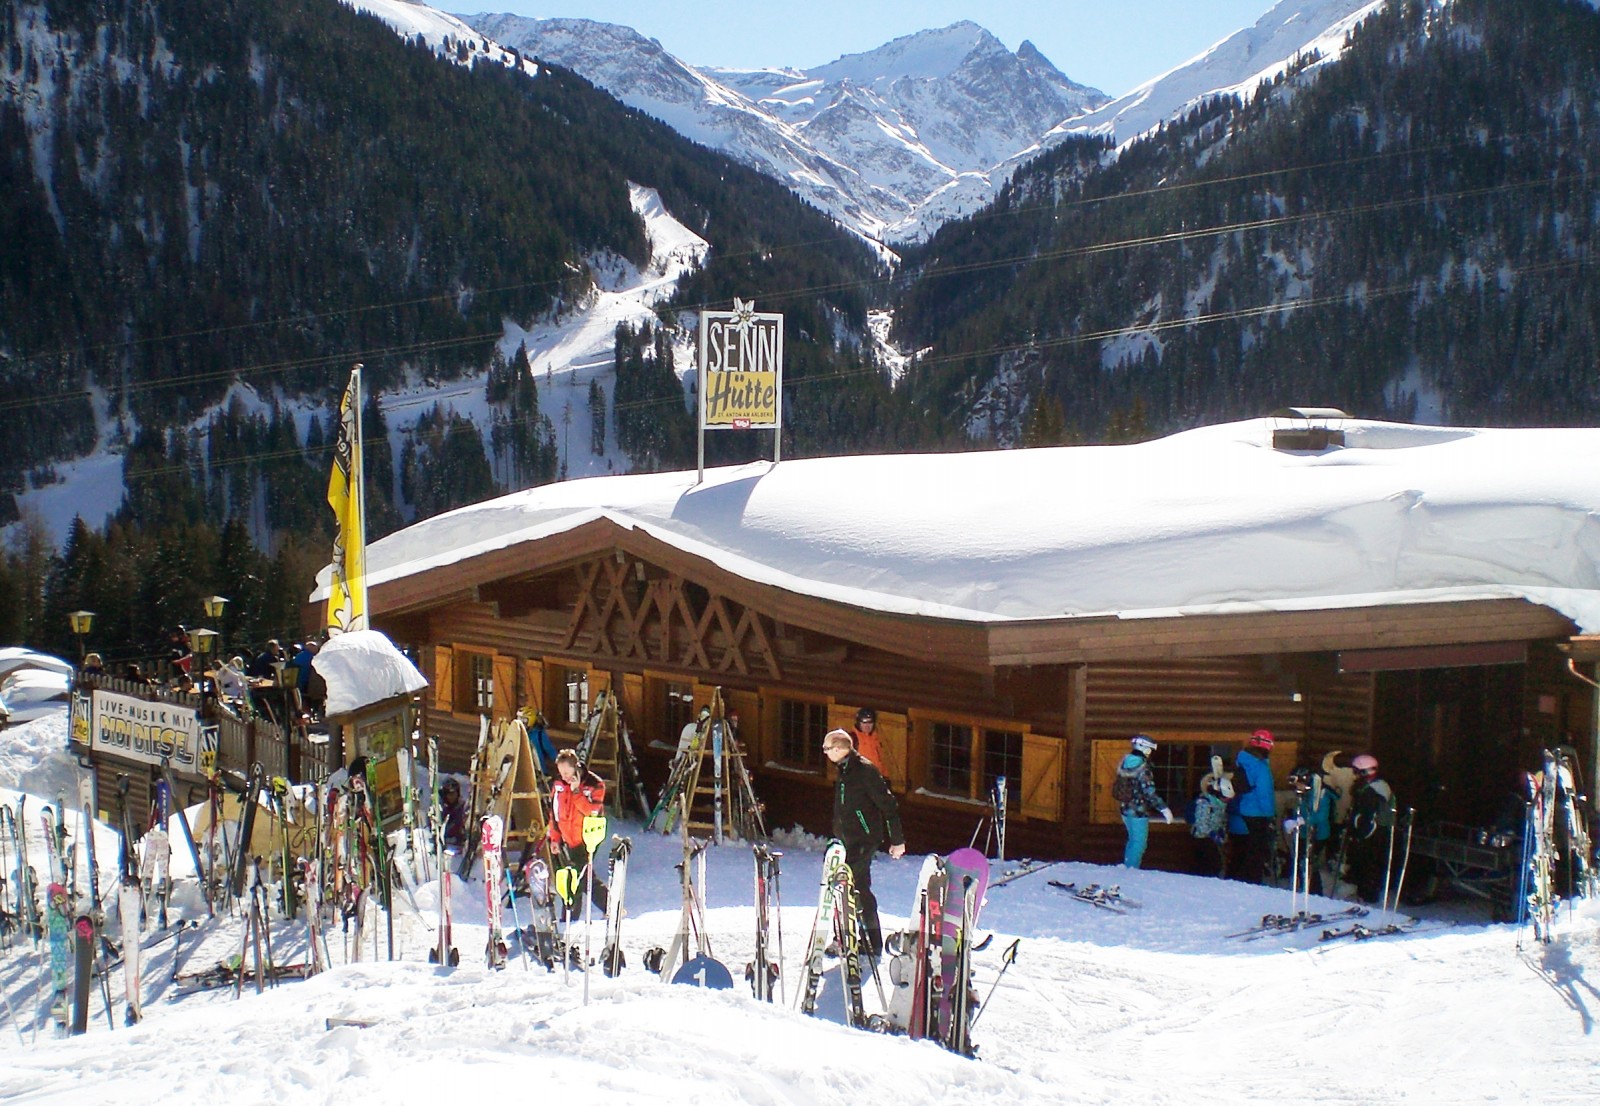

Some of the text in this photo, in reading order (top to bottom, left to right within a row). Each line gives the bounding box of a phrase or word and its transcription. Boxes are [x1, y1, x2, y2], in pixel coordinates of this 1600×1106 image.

[709, 321, 776, 373] SENN
[708, 371, 774, 418] Hütte
[100, 699, 166, 723] LIVE-MUSIK
[172, 713, 193, 729] MIT
[99, 714, 132, 750] DIDI
[134, 722, 194, 764] DIESEL
[693, 967, 706, 987] 1
